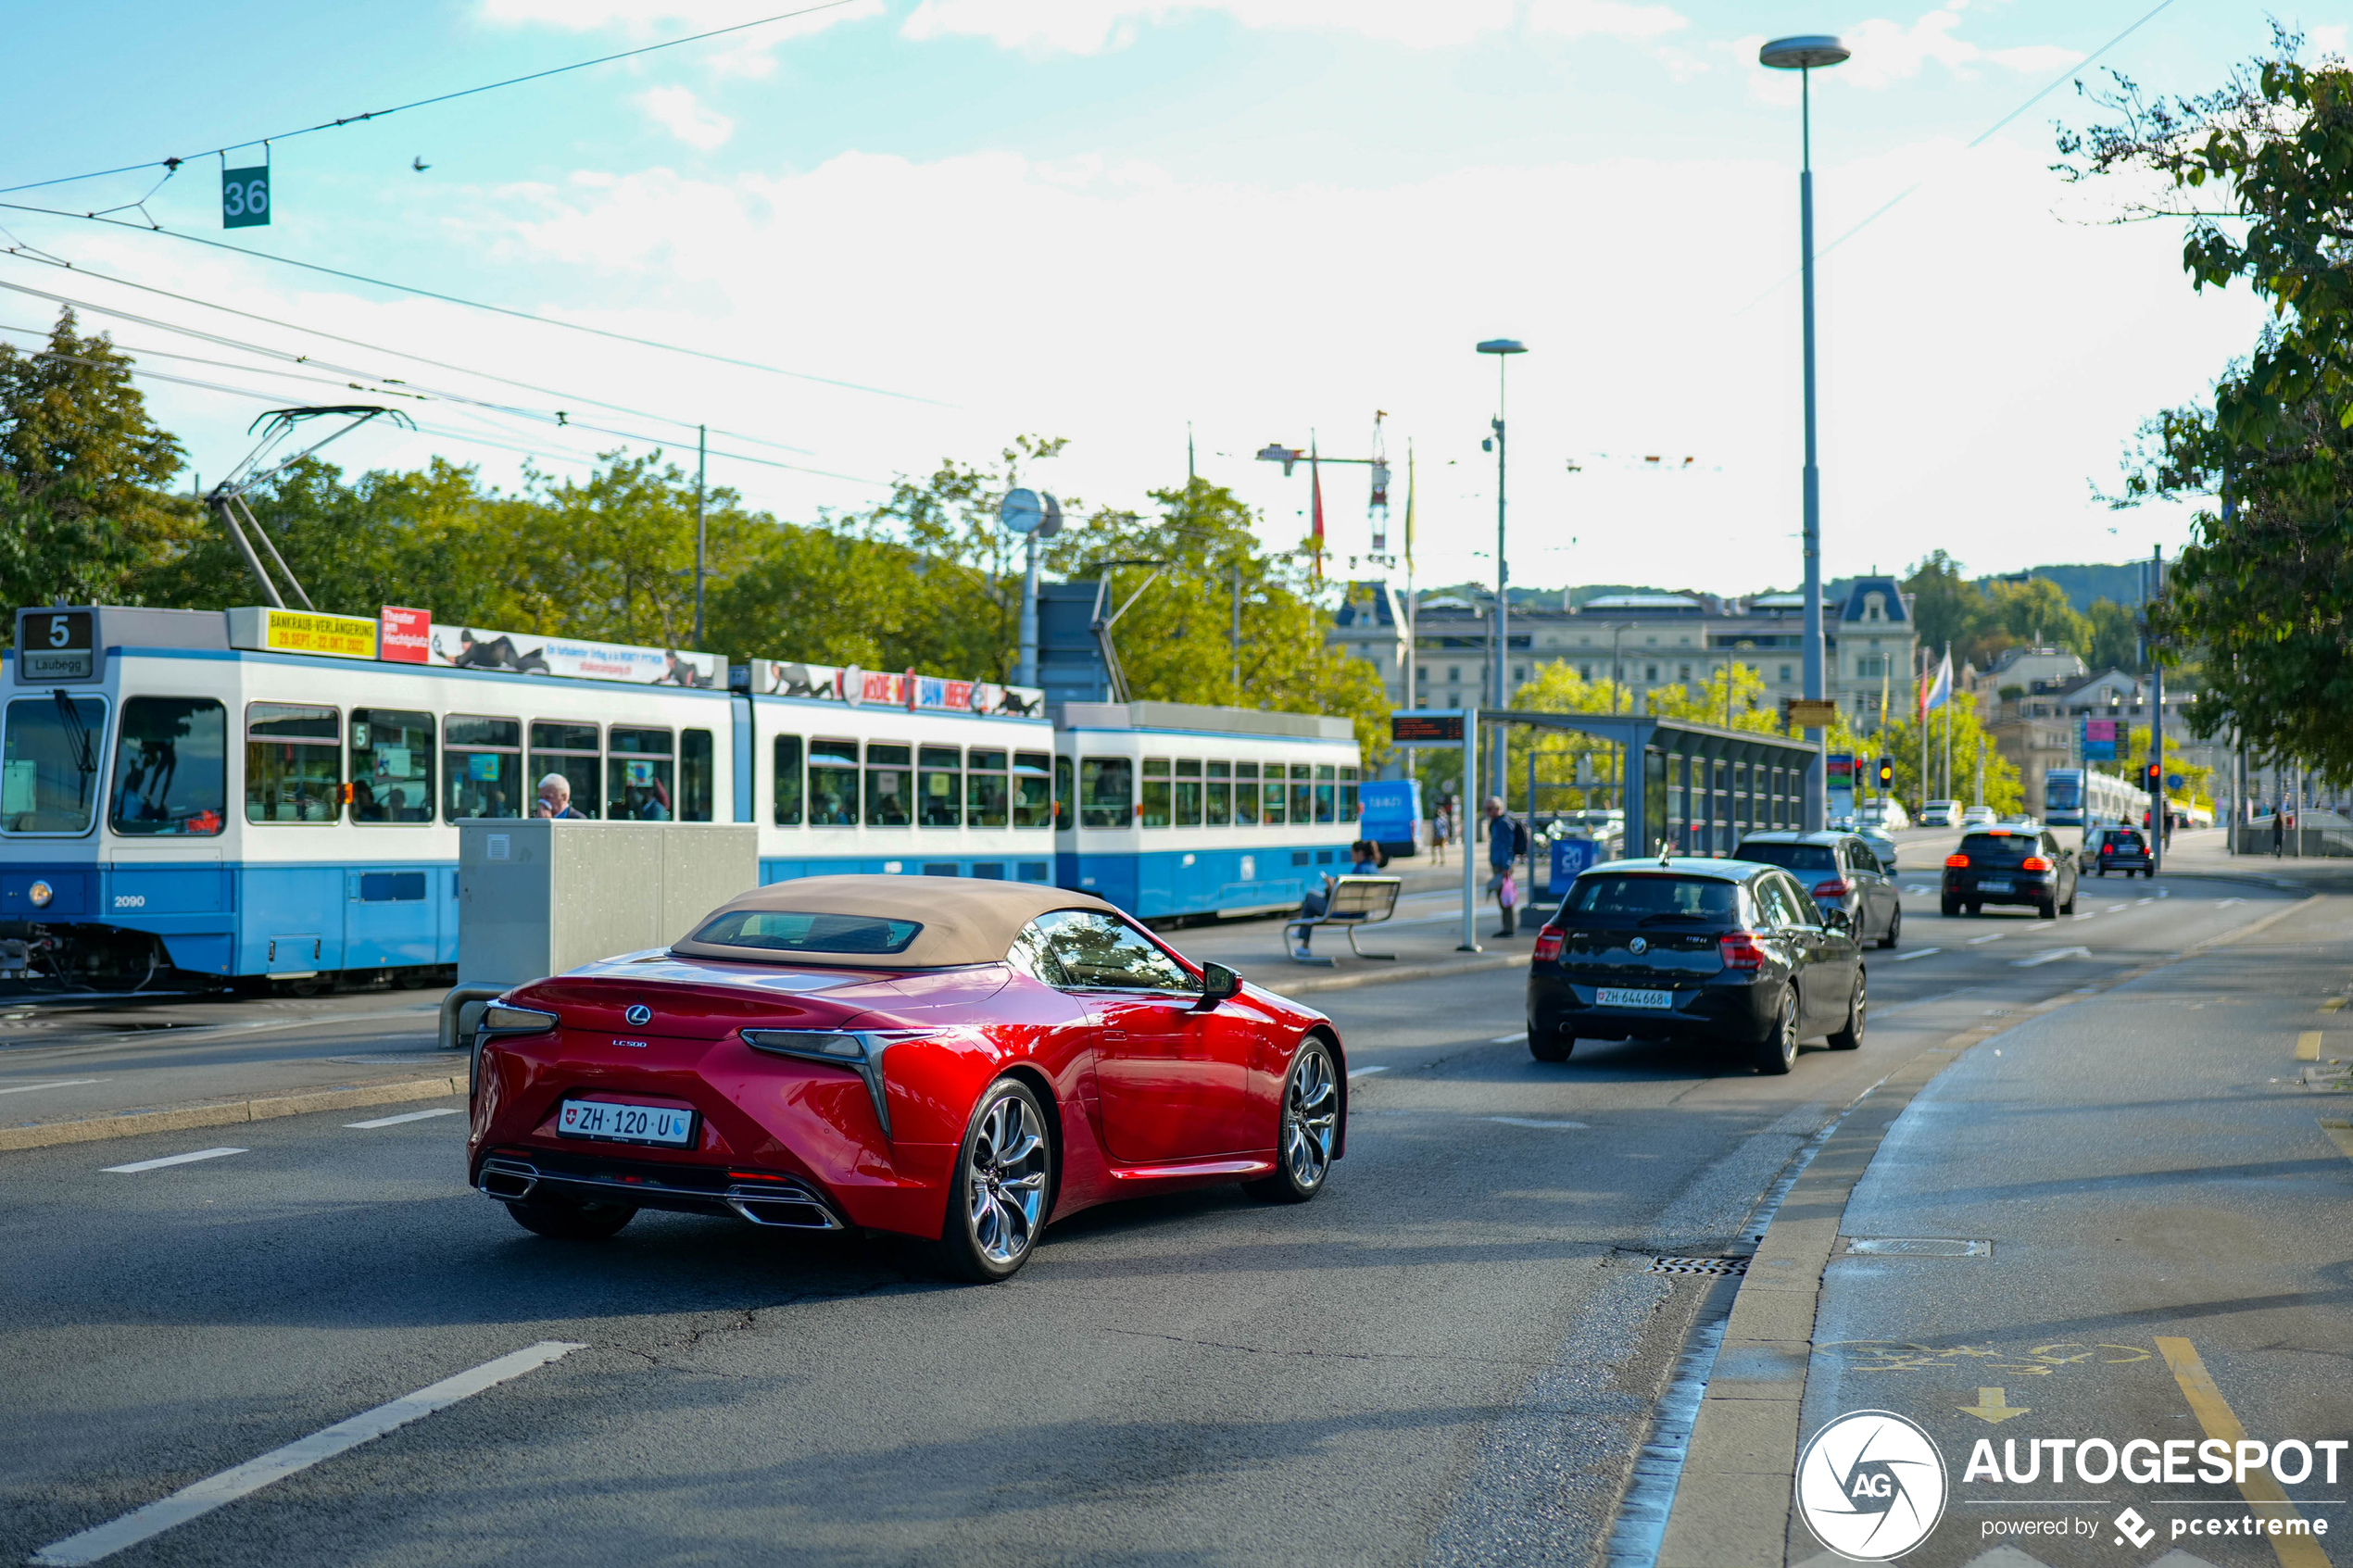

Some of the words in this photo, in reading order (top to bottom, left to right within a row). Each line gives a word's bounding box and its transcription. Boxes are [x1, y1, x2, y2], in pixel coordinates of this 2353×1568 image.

[224, 179, 268, 216] 36
[383, 609, 416, 624] Theater
[49, 615, 69, 647] 5
[384, 622, 397, 632] am
[35, 659, 82, 672] Laubegg
[356, 725, 366, 746] 5
[114, 895, 145, 908] 2090
